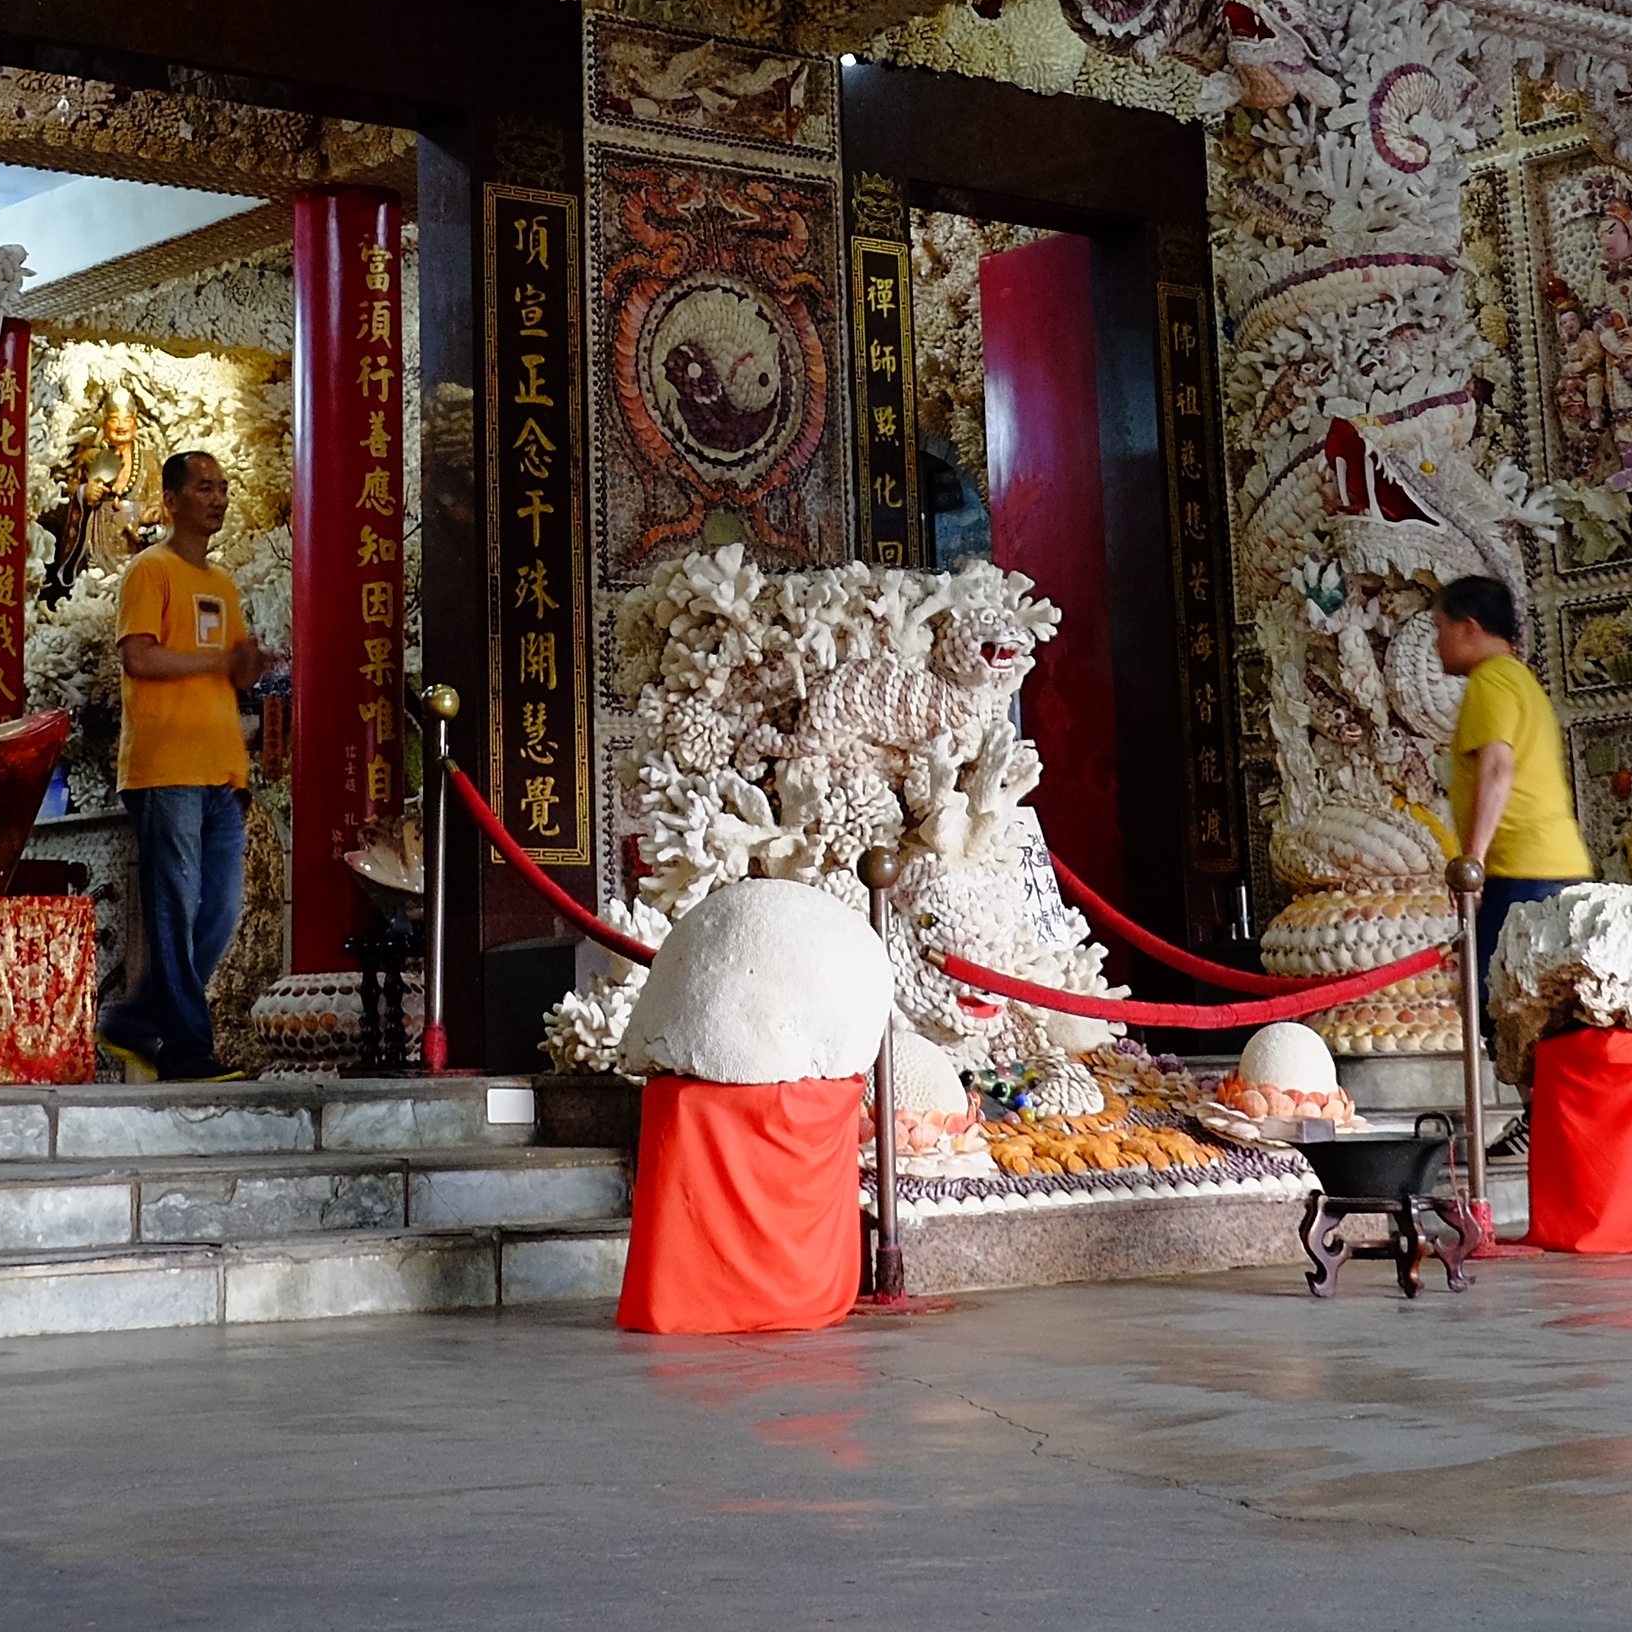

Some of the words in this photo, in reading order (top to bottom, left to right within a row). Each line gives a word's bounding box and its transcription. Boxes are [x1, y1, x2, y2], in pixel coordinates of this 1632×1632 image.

[354, 240, 398, 823] 富須行善應知因果唯自
